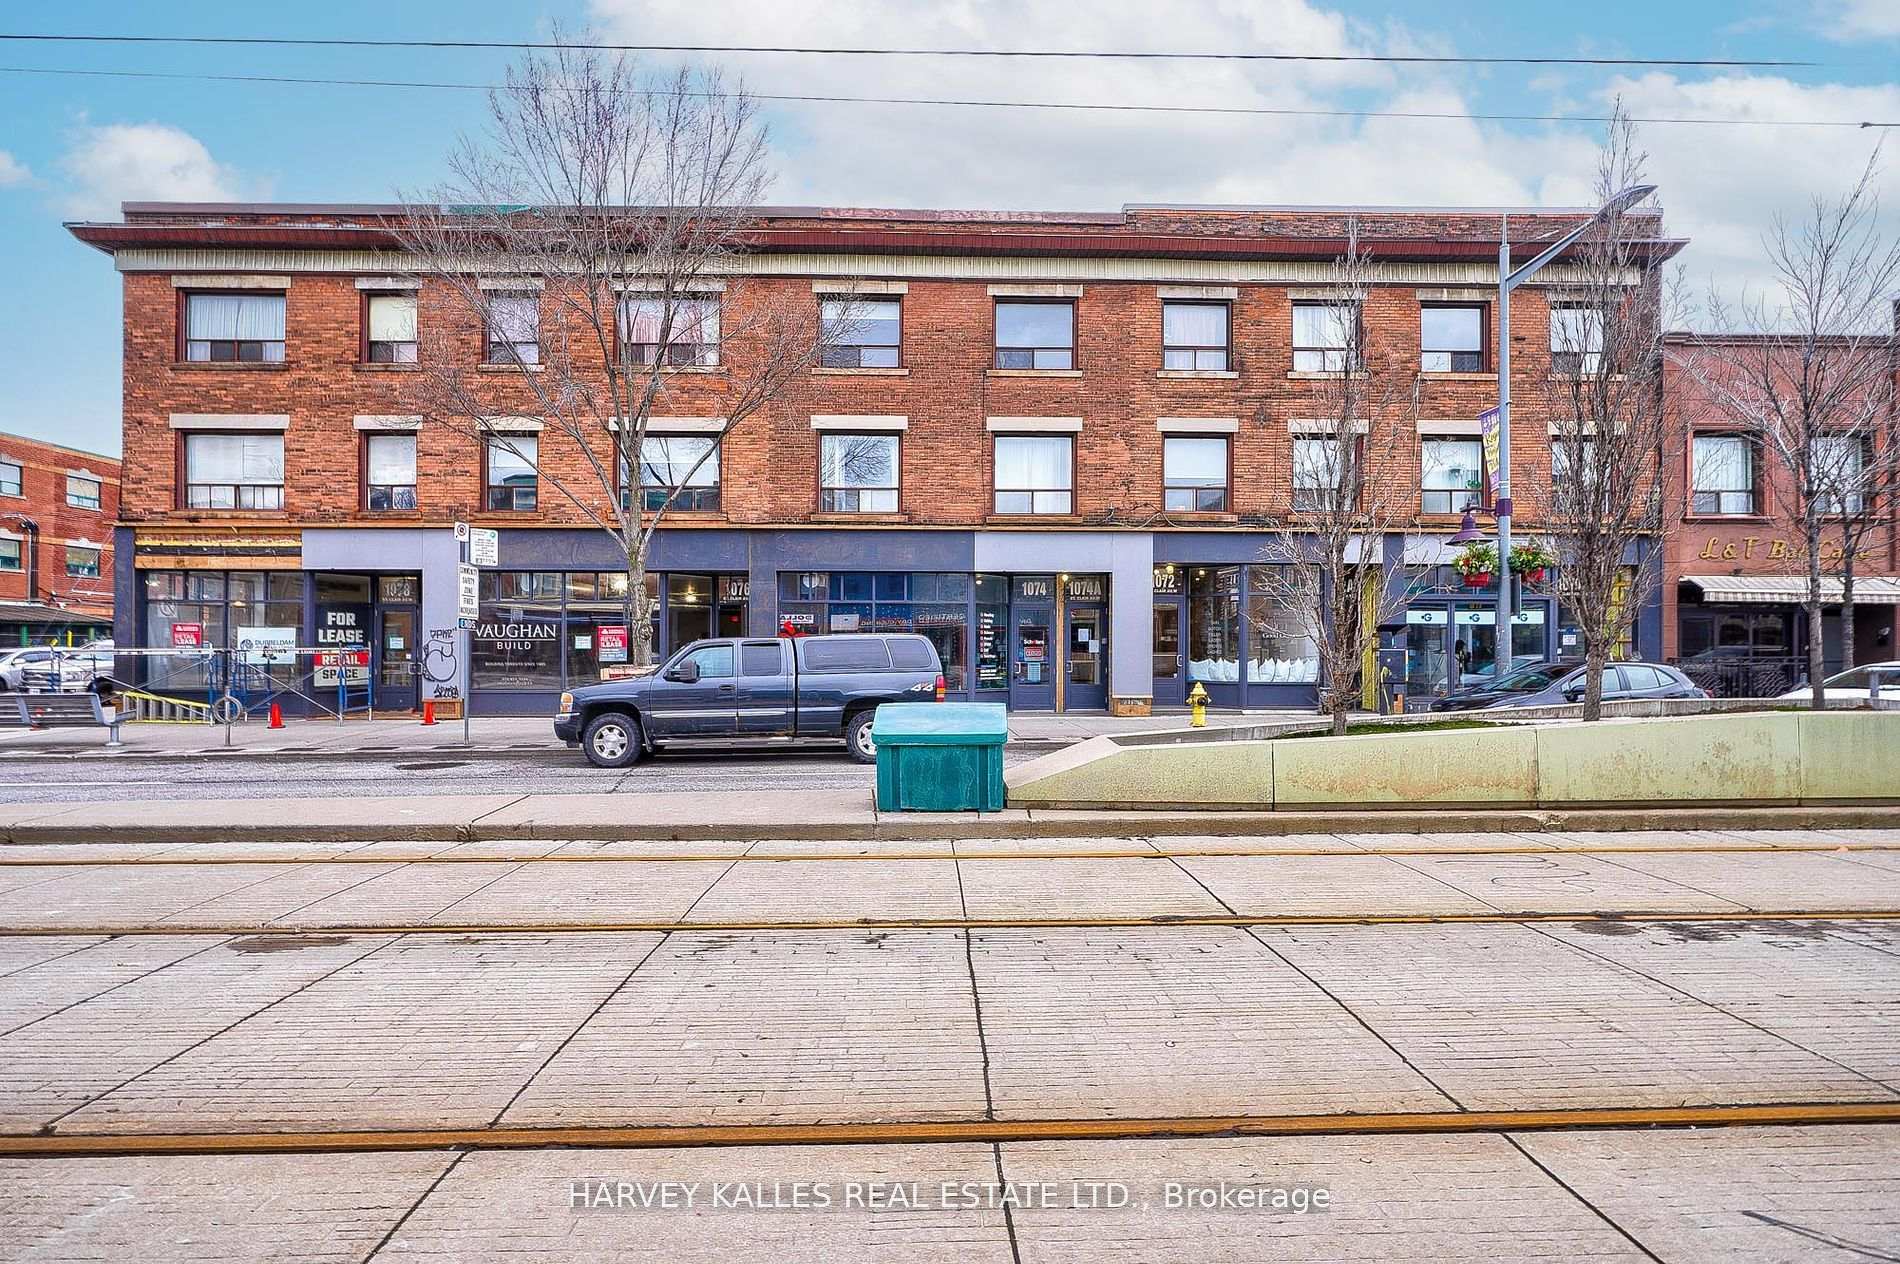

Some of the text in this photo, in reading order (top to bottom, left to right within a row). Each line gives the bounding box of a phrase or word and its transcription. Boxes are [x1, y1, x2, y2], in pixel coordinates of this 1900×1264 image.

[1022, 582, 1047, 596] 1074
[1068, 581, 1101, 596] 1074A
[327, 612, 356, 626] FOR
[1424, 613, 1433, 622] G
[1472, 613, 1481, 623] G
[1520, 613, 1529, 622] G
[318, 628, 364, 643] LEASE
[475, 624, 557, 638] VAUGHAN
[496, 641, 532, 650] BUILD
